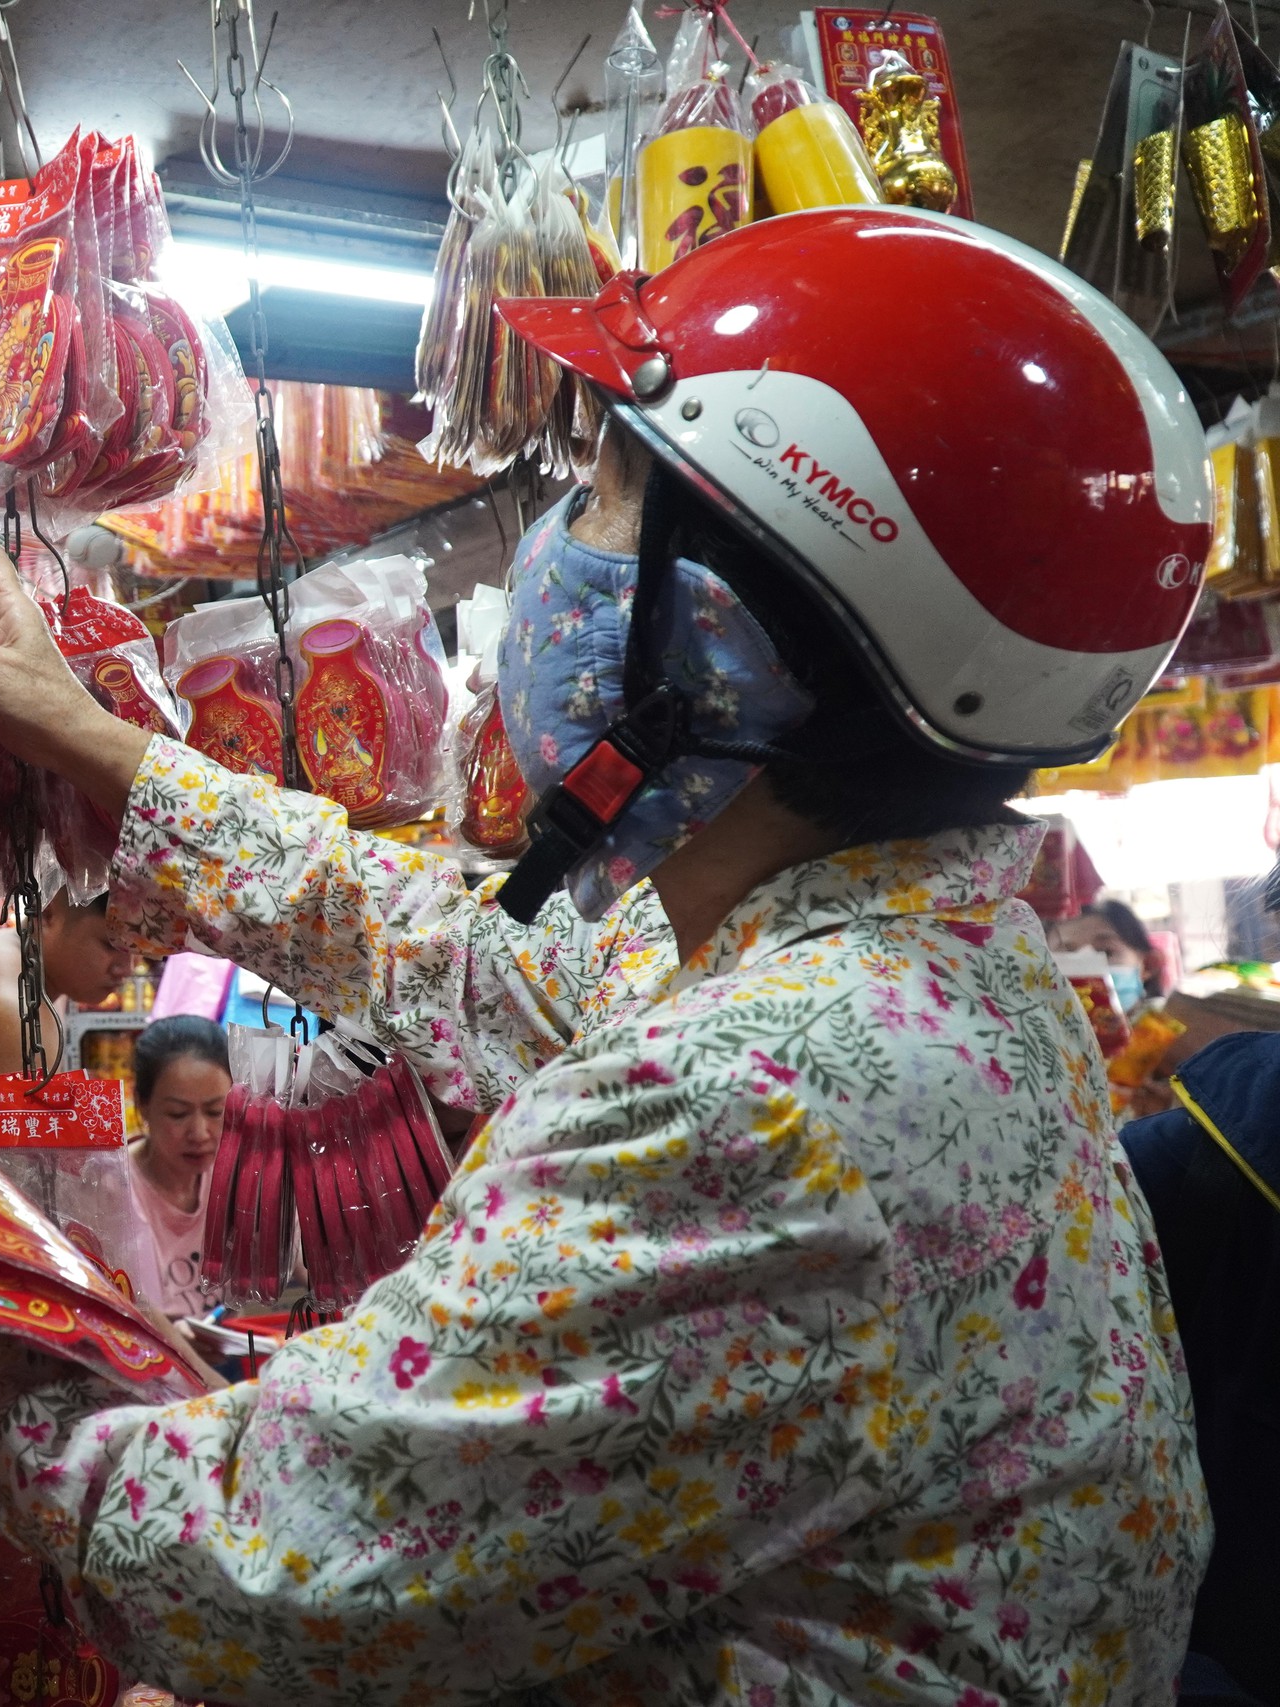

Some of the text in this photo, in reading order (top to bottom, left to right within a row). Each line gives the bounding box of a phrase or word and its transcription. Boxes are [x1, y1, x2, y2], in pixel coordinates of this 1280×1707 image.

[753, 456, 843, 531] Win My Heart
[779, 436, 900, 544] KYMCO
[1, 1116, 64, 1140] 瑞豐年
